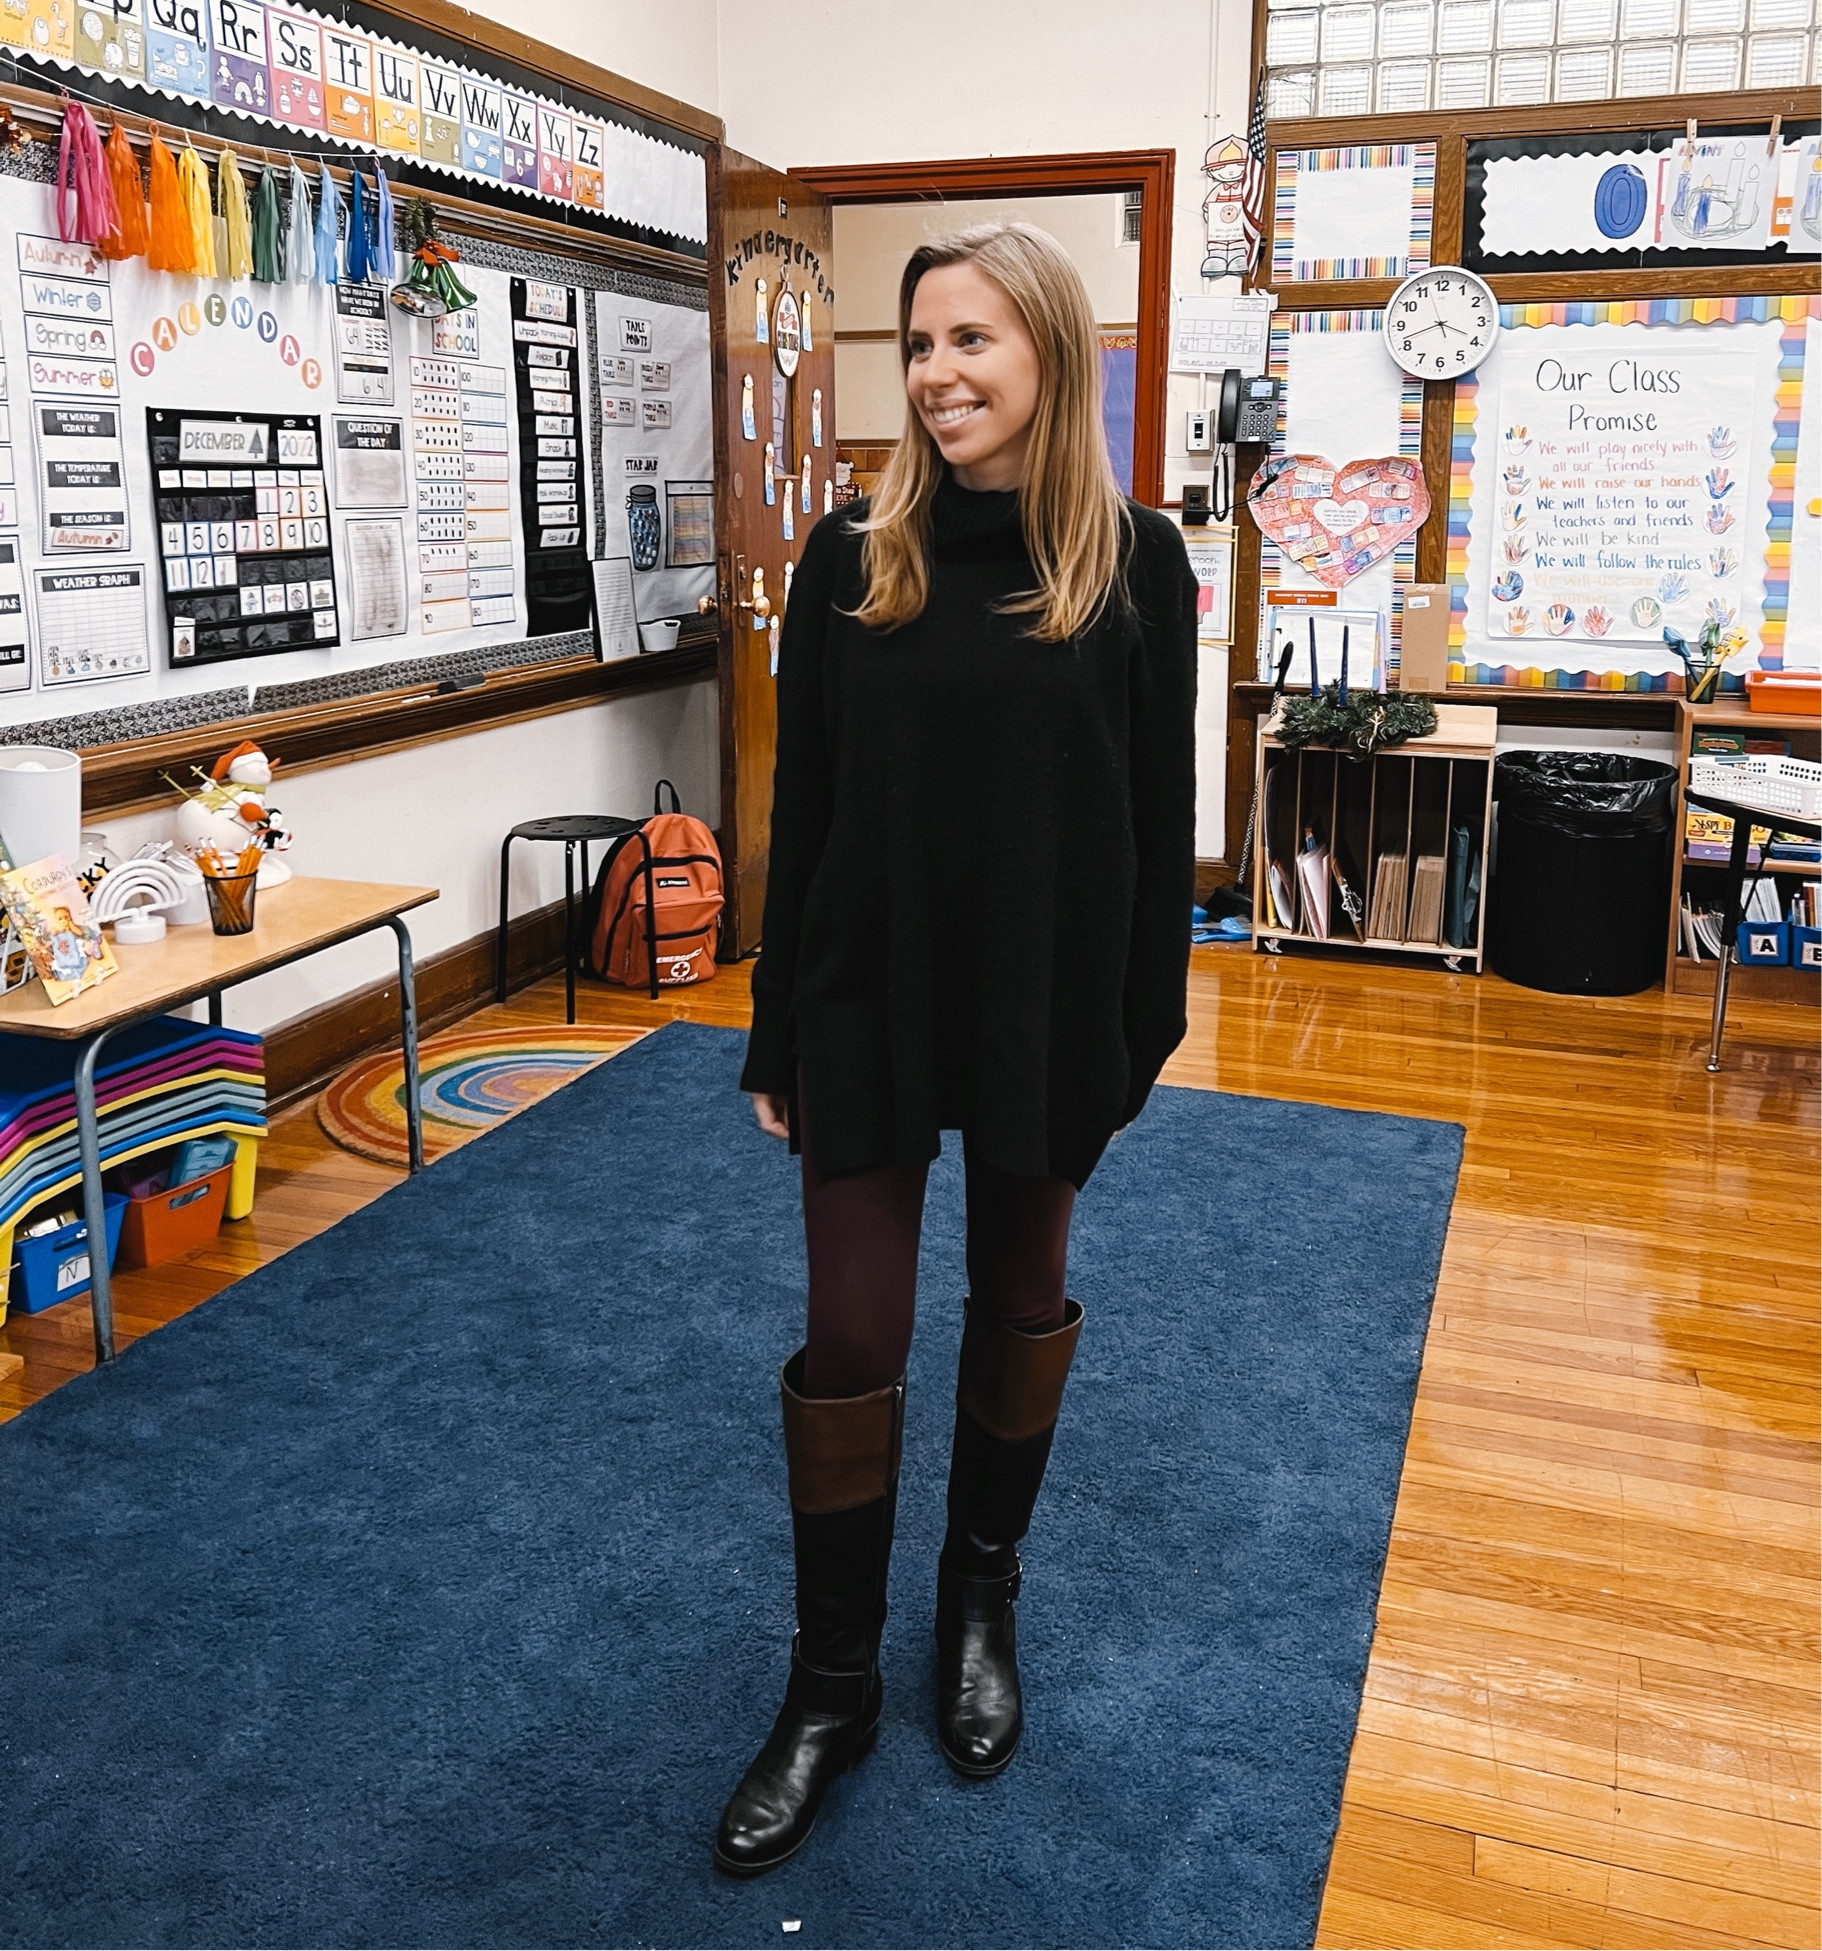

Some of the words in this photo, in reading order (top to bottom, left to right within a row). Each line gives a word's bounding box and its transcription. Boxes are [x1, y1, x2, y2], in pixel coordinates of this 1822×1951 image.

[153, 0, 206, 52] Qq
[221, 0, 258, 52] Rr
[278, 20, 312, 71] Ss
[331, 36, 363, 87] Tt
[379, 52, 413, 102] Uu
[425, 68, 456, 116] Vv
[462, 83, 499, 130] Ww
[507, 98, 533, 143] Xx
[543, 112, 566, 161] Yy
[576, 125, 599, 167] Zz
[24, 241, 83, 267] Autumn
[531, 285, 562, 301] TODAY'S
[1415, 287, 1428, 298] 11
[1434, 280, 1450, 291] 12
[1459, 285, 1465, 295] 1
[33, 284, 83, 309] Winter
[1471, 297, 1480, 308] 2
[1402, 301, 1417, 312] 10
[465, 312, 475, 328] IN
[1396, 320, 1406, 331] 9
[1477, 316, 1486, 327] 3
[35, 323, 86, 351] Spring
[133, 296, 319, 386] CALENDAR
[435, 332, 476, 352] SCHOOL
[1470, 336, 1479, 347] 4
[1403, 340, 1412, 351] 8
[1417, 353, 1426, 364] 7
[1435, 357, 1445, 368] 6
[1456, 350, 1465, 361] 5
[33, 363, 96, 387] Summer
[1537, 359, 1592, 391] Our
[1609, 359, 1681, 394] Class
[56, 412, 69, 421] THE
[70, 413, 100, 422] WEATHER
[1569, 404, 1658, 432] Promise
[62, 424, 86, 433] TODAY
[348, 423, 383, 434] QUESTION
[184, 431, 245, 450] DECEMBER
[280, 435, 314, 457] 2022
[357, 437, 369, 447] THE
[370, 438, 386, 448] DAY
[1539, 442, 1557, 455] We
[1567, 441, 1590, 454] will
[1598, 443, 1626, 459] play
[1632, 440, 1667, 457] nicely
[1672, 440, 1698, 452] with
[55, 464, 67, 473] THE
[68, 464, 111, 473] TEMPERATURE
[625, 459, 642, 471] STAR
[644, 459, 658, 472] JAR
[1552, 460, 1567, 472] all
[1573, 462, 1592, 472] our
[1604, 458, 1655, 472] friends
[67, 475, 91, 484] TODAY
[1539, 476, 1556, 490] We
[1562, 477, 1585, 489] will
[1595, 475, 1626, 488] raise
[1634, 478, 1652, 488] our
[1661, 476, 1701, 488] hands
[285, 491, 293, 514] 2
[308, 490, 318, 513] 3
[1536, 497, 1555, 510] We
[1563, 496, 1585, 510] will
[1596, 495, 1635, 510] listen
[1646, 496, 1659, 509] to
[1666, 499, 1690, 509] our
[61, 515, 73, 524] THE
[75, 515, 102, 523] SEASON
[1553, 514, 1605, 528] teachers
[1613, 514, 1636, 526] and
[1646, 513, 1693, 527] friends
[57, 530, 103, 545] Autumn
[168, 527, 178, 550] 4
[192, 526, 204, 550] 5
[217, 526, 229, 549] 6
[241, 525, 250, 548] 7
[263, 524, 274, 547] 8
[287, 523, 298, 545] 9
[309, 521, 323, 543] 10
[1536, 531, 1555, 546] We
[1563, 533, 1589, 546] will
[1601, 531, 1618, 545] be
[1627, 531, 1660, 545] kind
[1535, 553, 1554, 568] We
[1563, 554, 1585, 568] will
[1597, 550, 1636, 569] follow
[1645, 554, 1664, 569] the
[1668, 553, 1702, 570] rules
[171, 562, 186, 587] 11
[196, 560, 209, 584] 12
[53, 576, 97, 589] WEATHER
[99, 574, 131, 586] GRAPH
[1760, 939, 1775, 952] A
[65, 1260, 79, 1283] N
